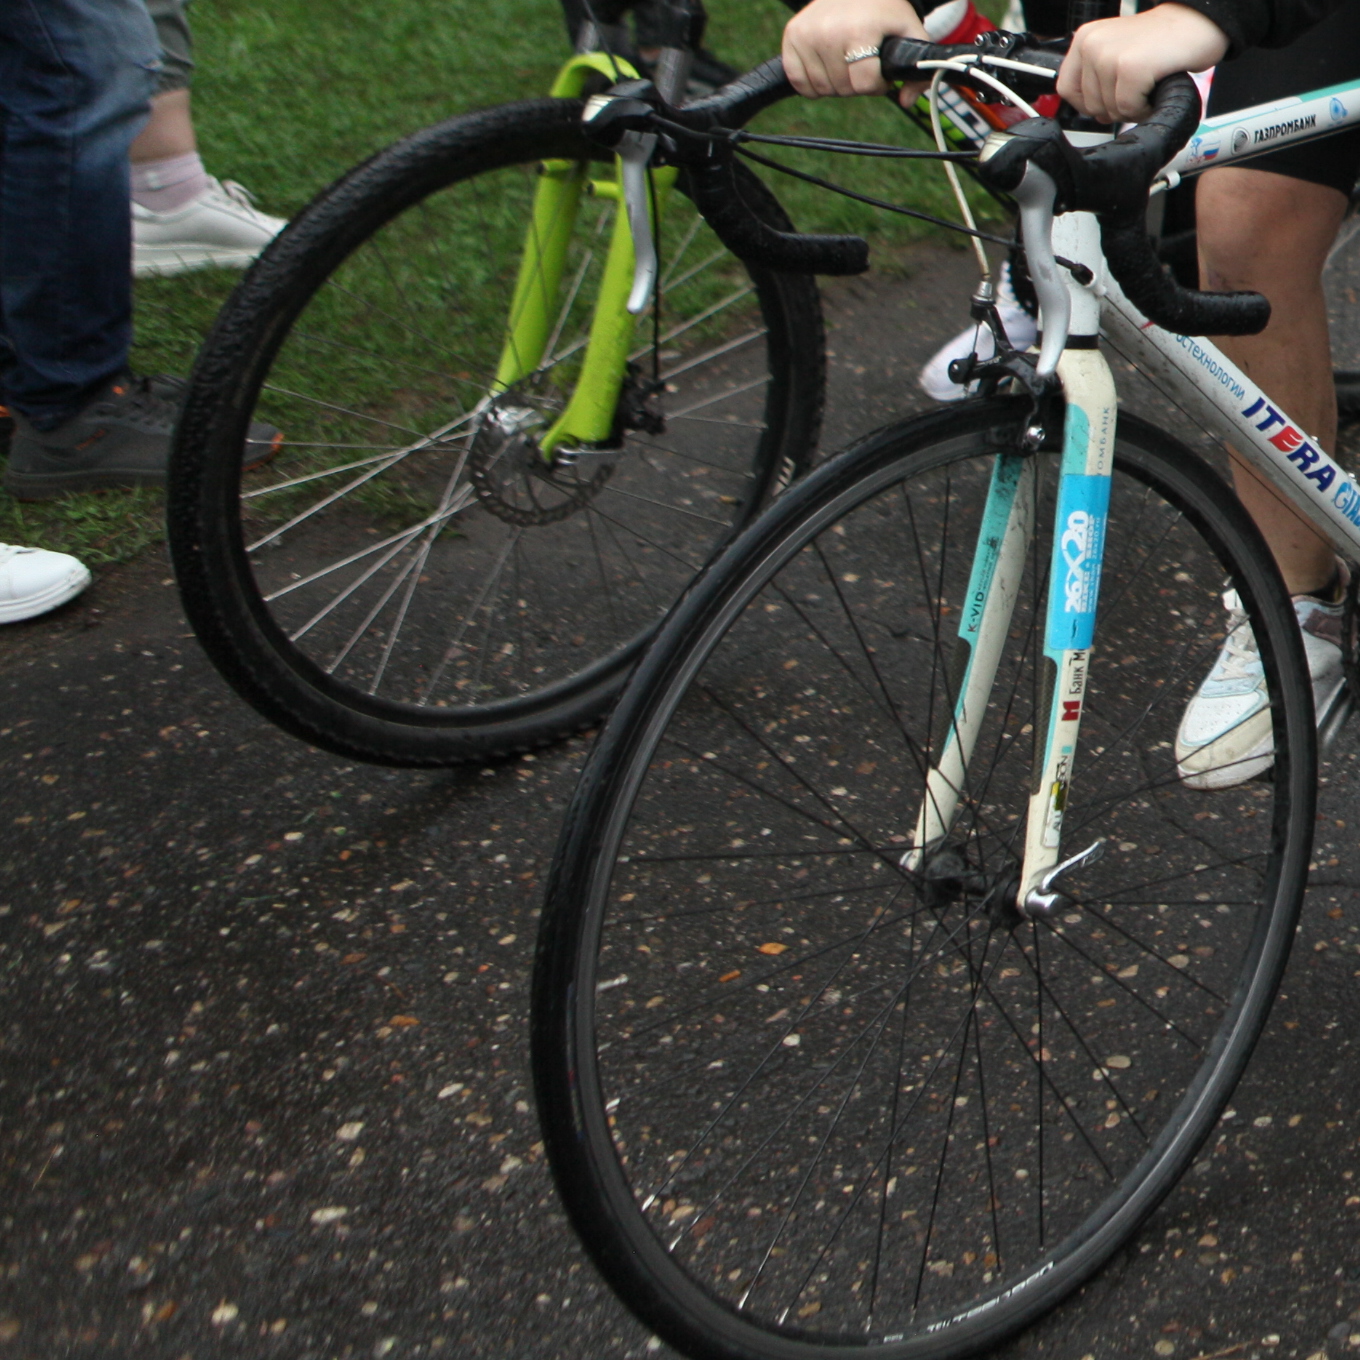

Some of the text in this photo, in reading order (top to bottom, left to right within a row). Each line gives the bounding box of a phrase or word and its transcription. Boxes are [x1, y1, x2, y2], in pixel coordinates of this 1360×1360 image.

[1254, 114, 1317, 144] ГАЗПРОМБАНК
[1173, 331, 1247, 401] остехнологии
[1097, 407, 1110, 477] ОМБАНК
[1241, 397, 1338, 493] ITERA
[968, 592, 985, 633] K-VID
[1069, 665, 1085, 695] Банк
